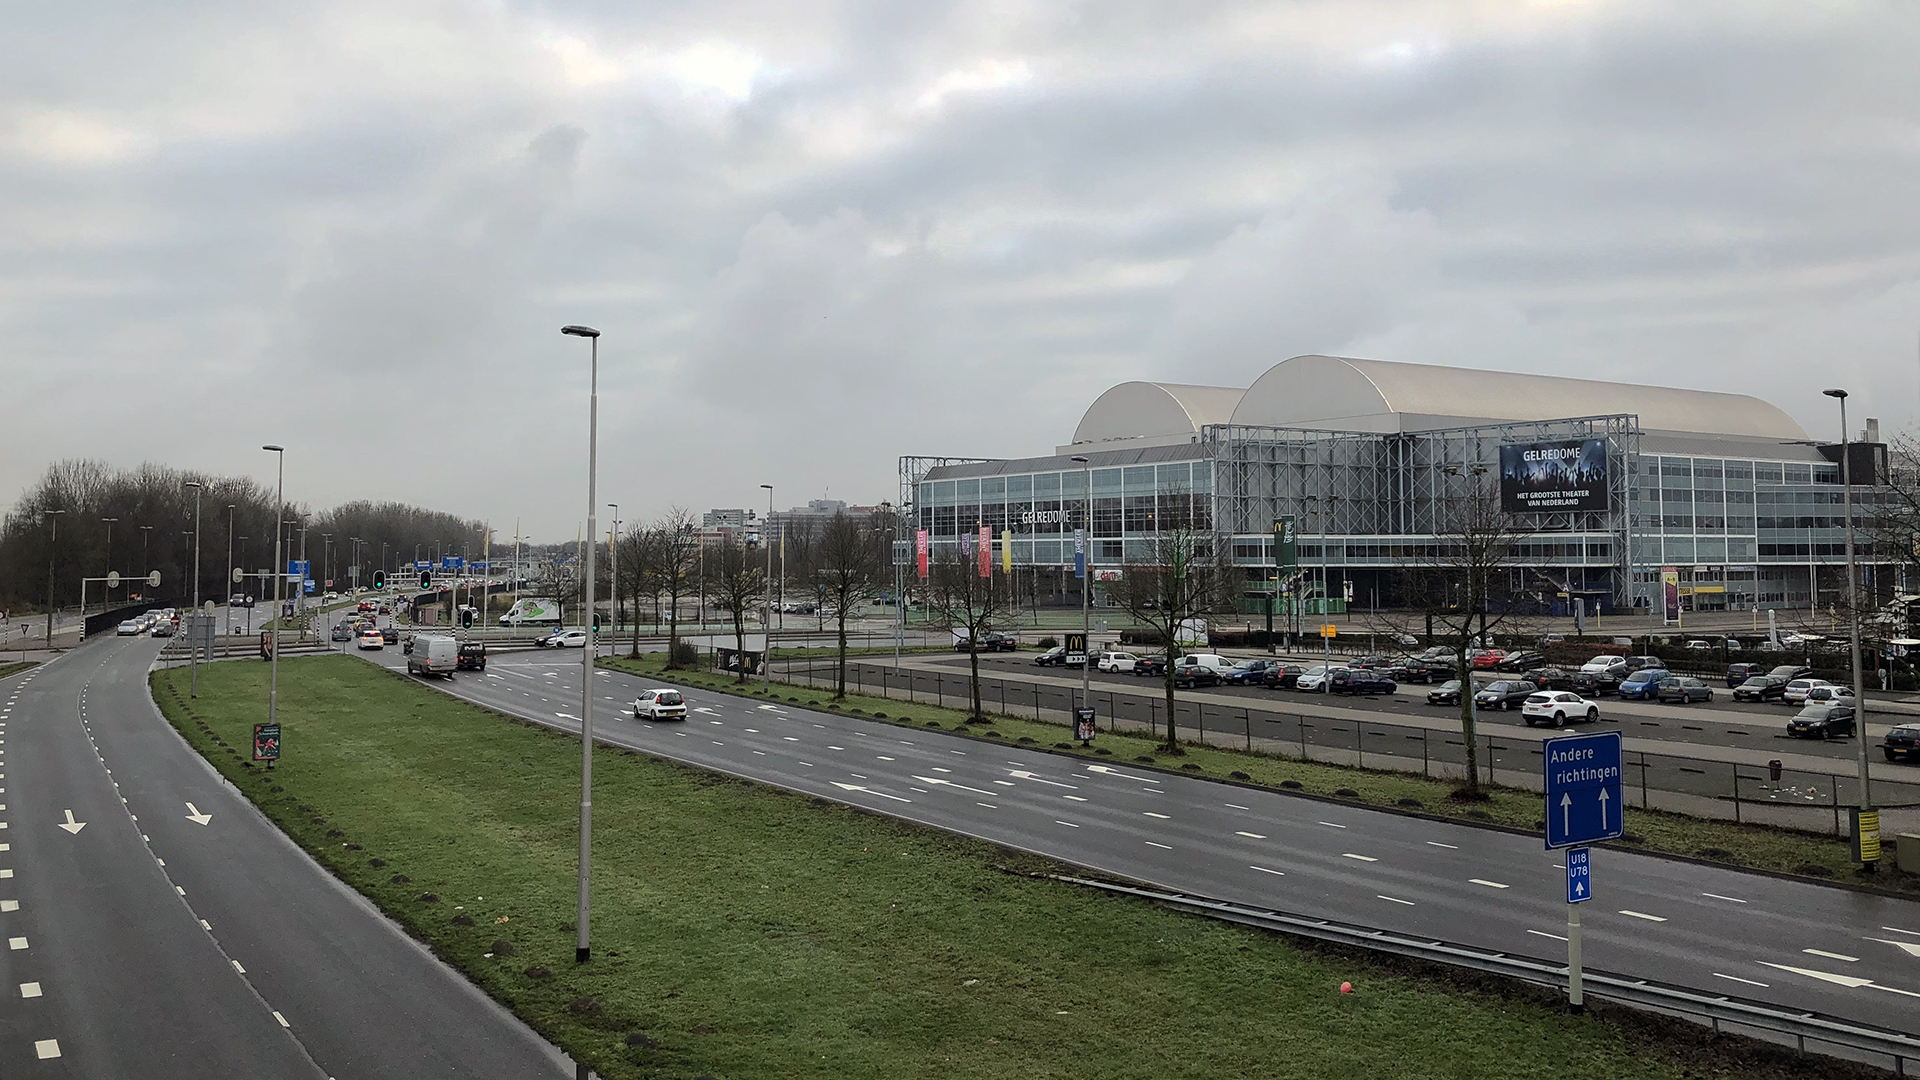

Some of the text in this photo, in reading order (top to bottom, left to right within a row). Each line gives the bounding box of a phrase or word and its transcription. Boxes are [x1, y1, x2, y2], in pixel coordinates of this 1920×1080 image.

[1523, 447, 1581, 462] GELREDOME
[1530, 491, 1561, 499] GROOTSTE
[1022, 510, 1071, 523] GELREDOME
[1550, 748, 1594, 763] Andere
[1556, 766, 1618, 784] richtingen
[1571, 853, 1587, 864] U18
[1570, 866, 1588, 877] U78
